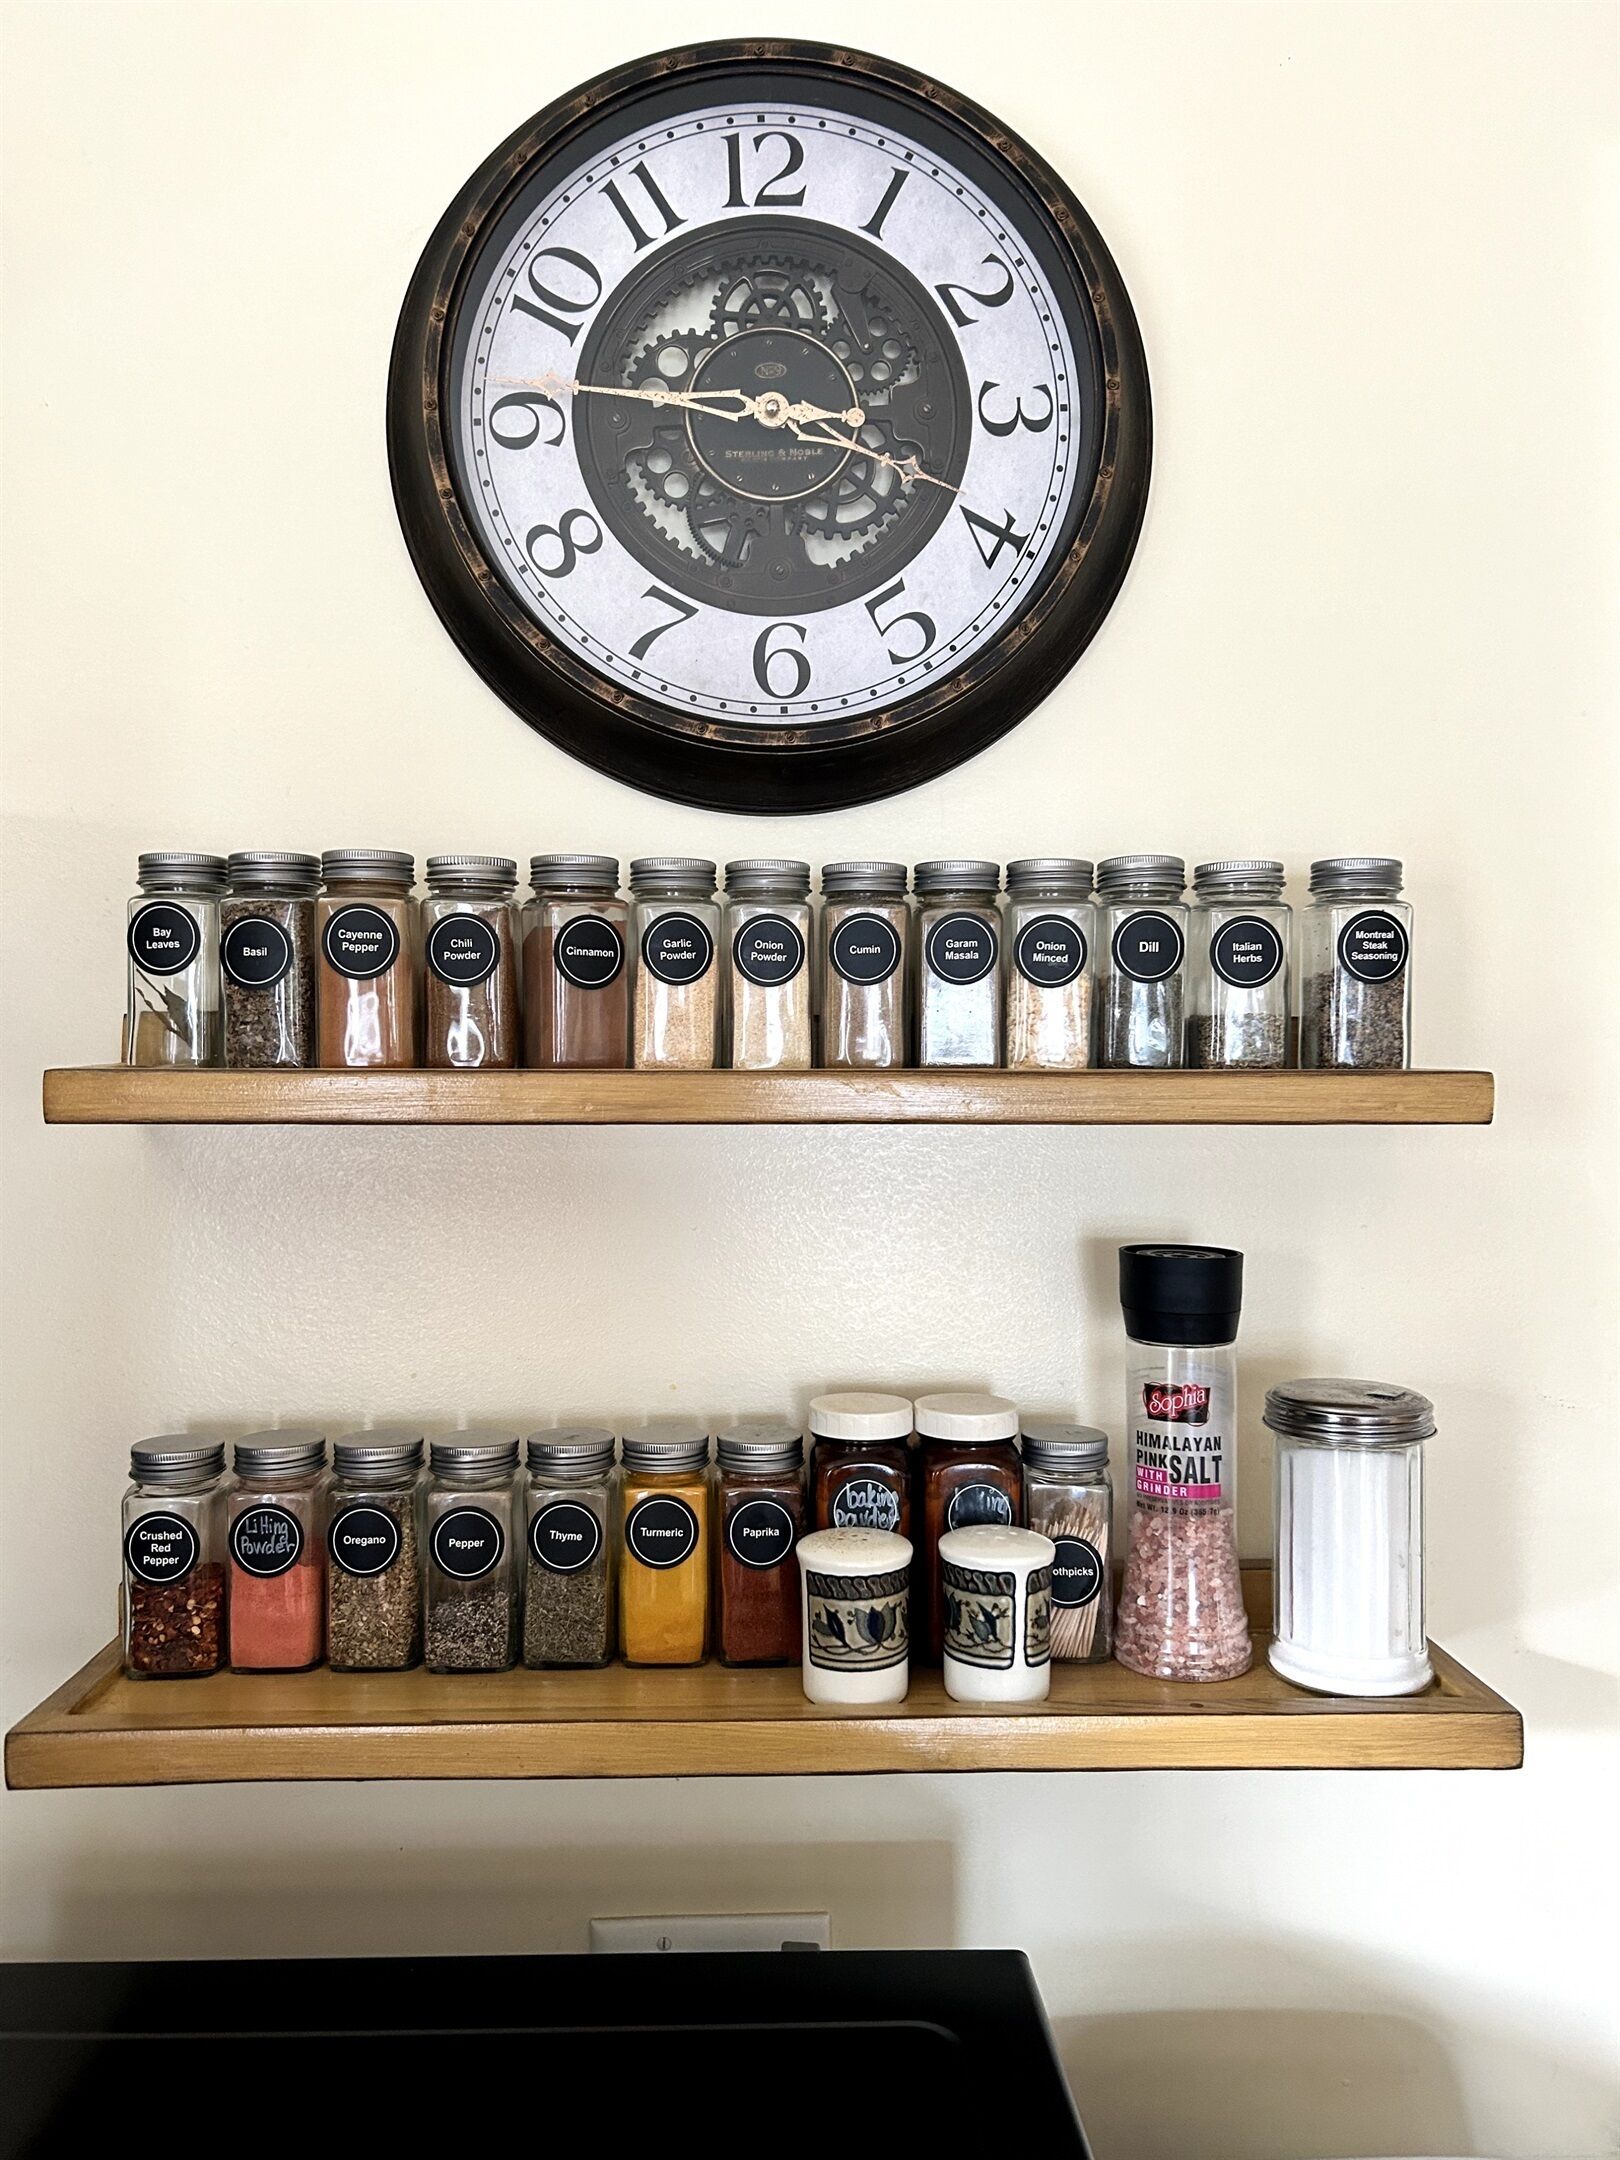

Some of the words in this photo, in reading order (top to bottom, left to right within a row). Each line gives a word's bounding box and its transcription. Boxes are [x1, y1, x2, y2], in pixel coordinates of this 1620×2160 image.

[720, 131, 807, 208] 12
[598, 161, 689, 254] 11
[856, 166, 911, 242] 1
[933, 252, 1016, 326] 2
[510, 247, 603, 348] 10
[978, 381, 1054, 437] 3
[488, 391, 566, 450] 9
[724, 449, 775, 458] STERLING
[778, 448, 786, 456] &
[790, 448, 824, 456] NOBLE
[524, 507, 603, 578] 8
[959, 503, 1034, 572] 4
[628, 584, 701, 661] 7
[863, 575, 938, 666] 5
[752, 622, 811, 699] 6
[152, 927, 172, 939] Bay
[337, 929, 383, 941] Cayenne
[1355, 930, 1395, 939] Montreal
[146, 940, 181, 950] Leaves
[341, 941, 379, 954] Pepper
[450, 938, 473, 948] Chili
[662, 938, 692, 949] Garlic
[754, 939, 784, 950] Onion
[945, 939, 978, 949] Garam
[1035, 940, 1067, 951] Onion
[1139, 941, 1160, 953] Dill
[1232, 941, 1263, 952] Italian
[1362, 940, 1388, 950] Steak
[243, 946, 268, 957] Basil
[443, 950, 482, 961] Powder
[566, 946, 614, 958] Cinnamon
[659, 950, 697, 961] Powder
[849, 944, 881, 955] Cumin
[945, 950, 979, 960] Masala
[750, 951, 788, 962] Powder
[1032, 952, 1069, 963] Minced
[1233, 953, 1263, 964] Herbs
[1351, 951, 1399, 962] Seasoning
[1149, 1385, 1207, 1418] Sophia
[1136, 1430, 1221, 1452] HIMALAYAN
[1136, 1449, 1168, 1469] PINK
[1169, 1455, 1222, 1484] SALT
[1136, 1466, 1163, 1482] WITH
[1136, 1479, 1188, 1497] GRINDER
[139, 1530, 183, 1541] Crushed
[549, 1530, 583, 1543] Thyme
[640, 1527, 684, 1537] Turmeric
[743, 1527, 780, 1539] Paprika
[240, 1534, 296, 1555] Powder
[343, 1535, 387, 1547] Oregano
[448, 1538, 485, 1550] Pepper
[150, 1543, 171, 1553] Red
[143, 1555, 180, 1567] Pepper
[1052, 1566, 1094, 1578] othpicks
